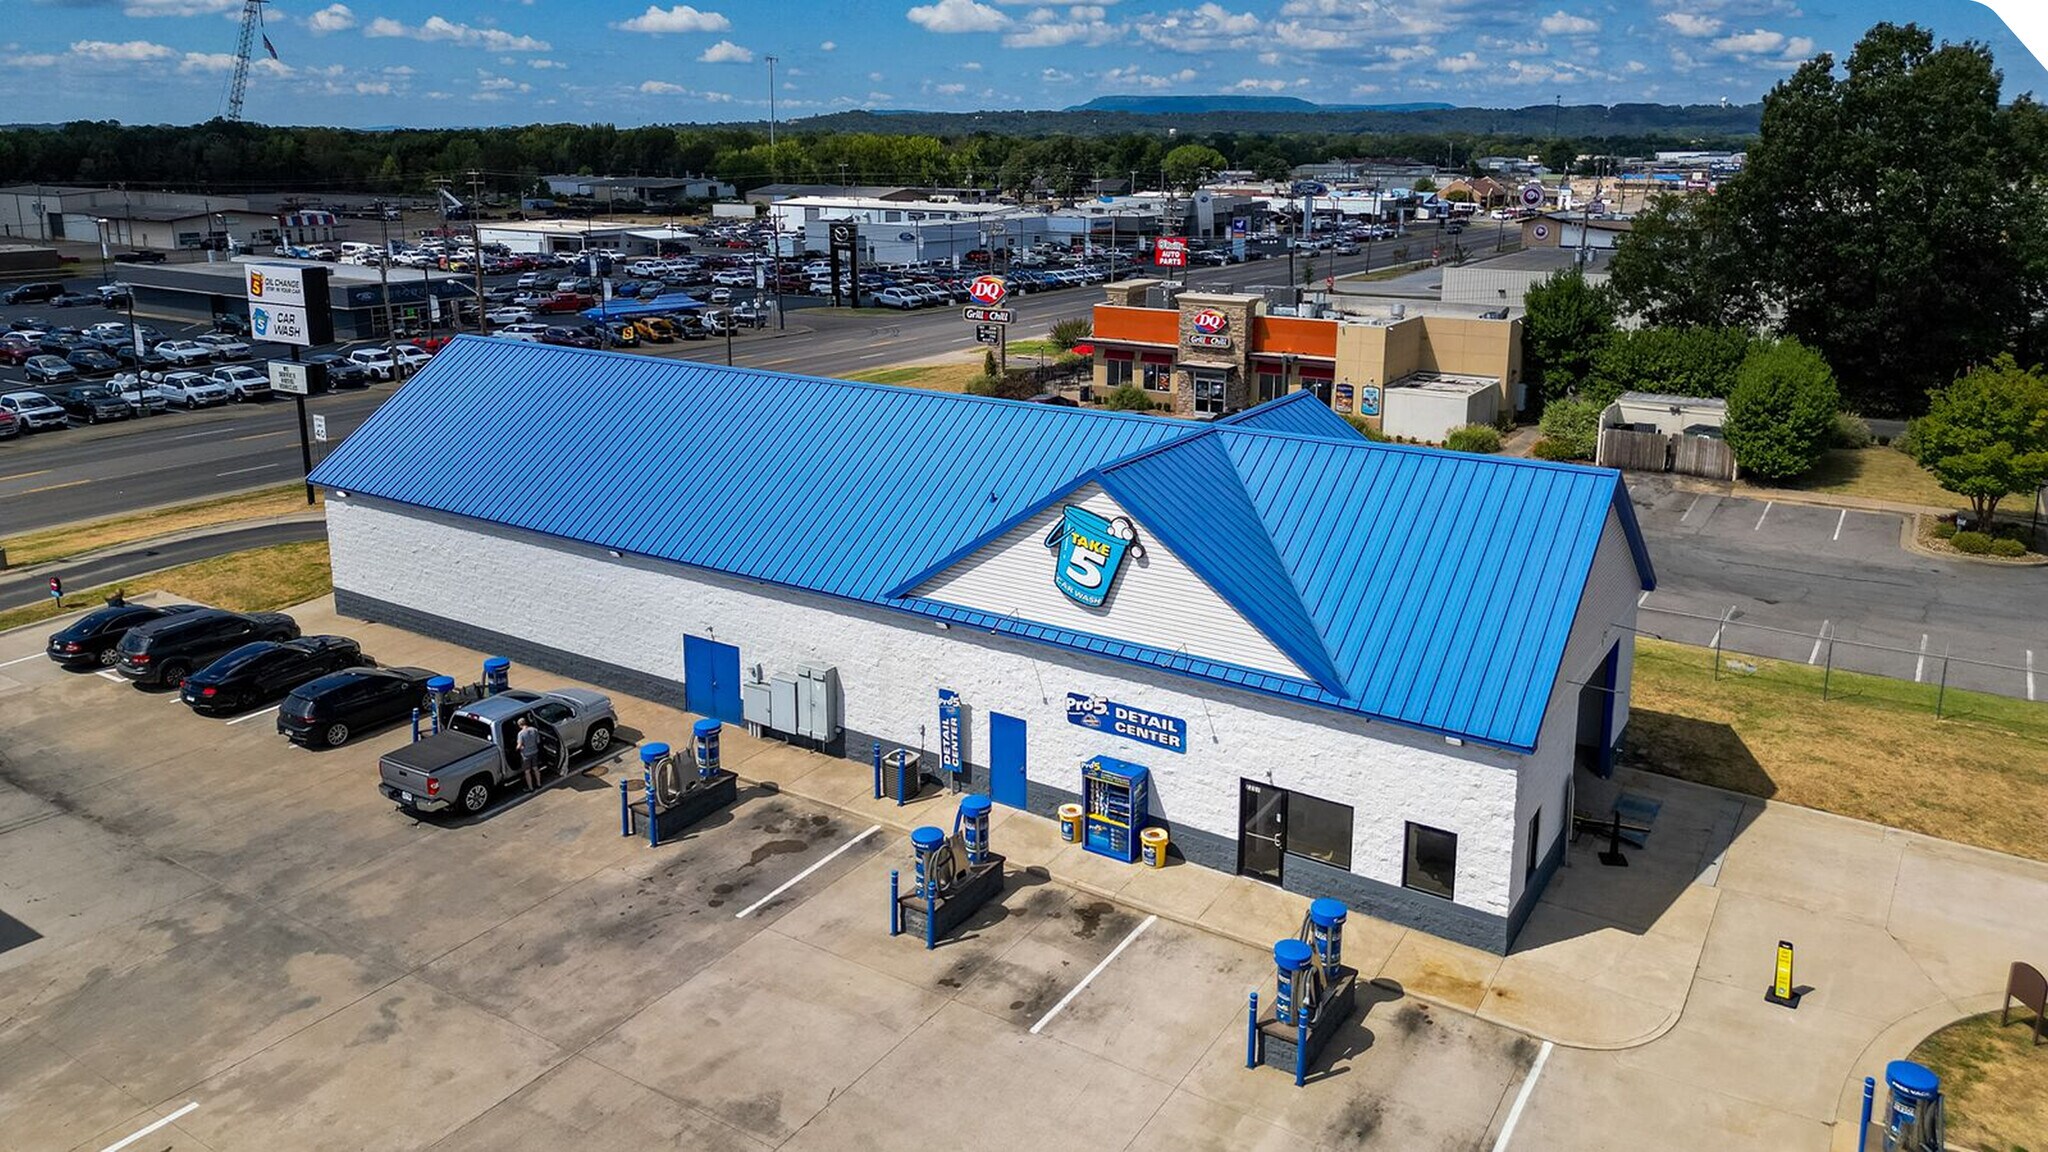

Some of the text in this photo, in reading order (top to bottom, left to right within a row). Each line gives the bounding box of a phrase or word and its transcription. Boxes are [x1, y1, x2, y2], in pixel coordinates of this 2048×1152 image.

[1159, 257, 1182, 266] PARTS
[1162, 250, 1180, 258] AUTO
[265, 277, 300, 288] OIL CHANGE
[975, 282, 999, 299] DQ
[277, 312, 295, 324] CAR
[966, 309, 984, 319] Grill
[989, 311, 1008, 321] Chill
[1199, 314, 1220, 329] DQ
[274, 324, 301, 337] WASH
[1071, 532, 1111, 557] TAKE
[1066, 546, 1107, 588] 5
[1074, 590, 1103, 605] WASH
[1115, 707, 1178, 733] DETAIL
[942, 717, 951, 765] DETAIL
[1114, 722, 1180, 747] CENTER
[950, 717, 960, 768] CENTER
